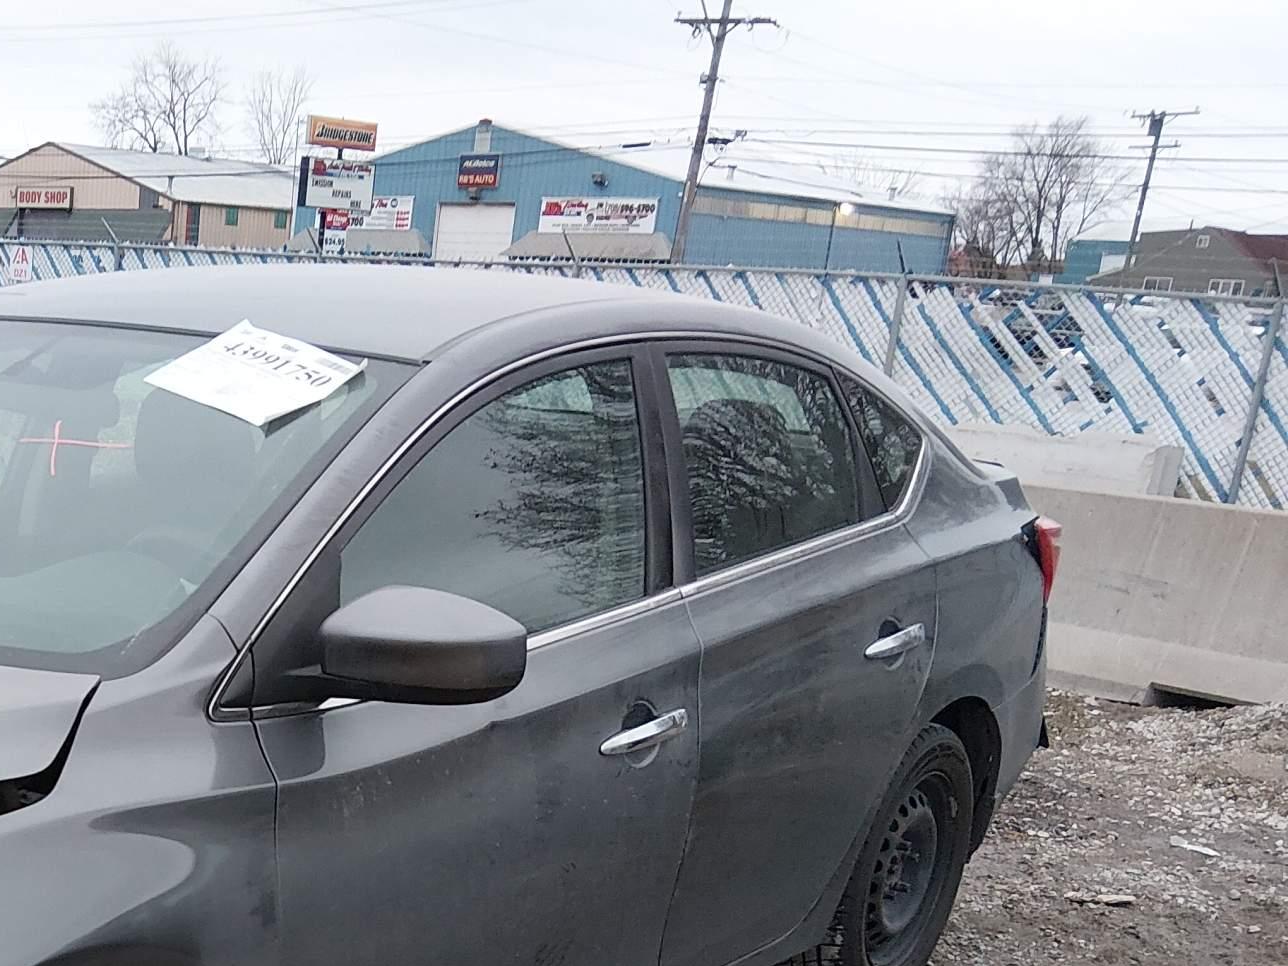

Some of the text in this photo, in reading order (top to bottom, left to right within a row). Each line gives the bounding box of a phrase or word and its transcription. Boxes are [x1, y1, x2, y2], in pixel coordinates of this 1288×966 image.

[316, 123, 374, 144] BRIDGESTONE
[475, 175, 494, 184] AUTO
[19, 191, 68, 204] BODY SHOP
[223, 342, 332, 387] 43991750
